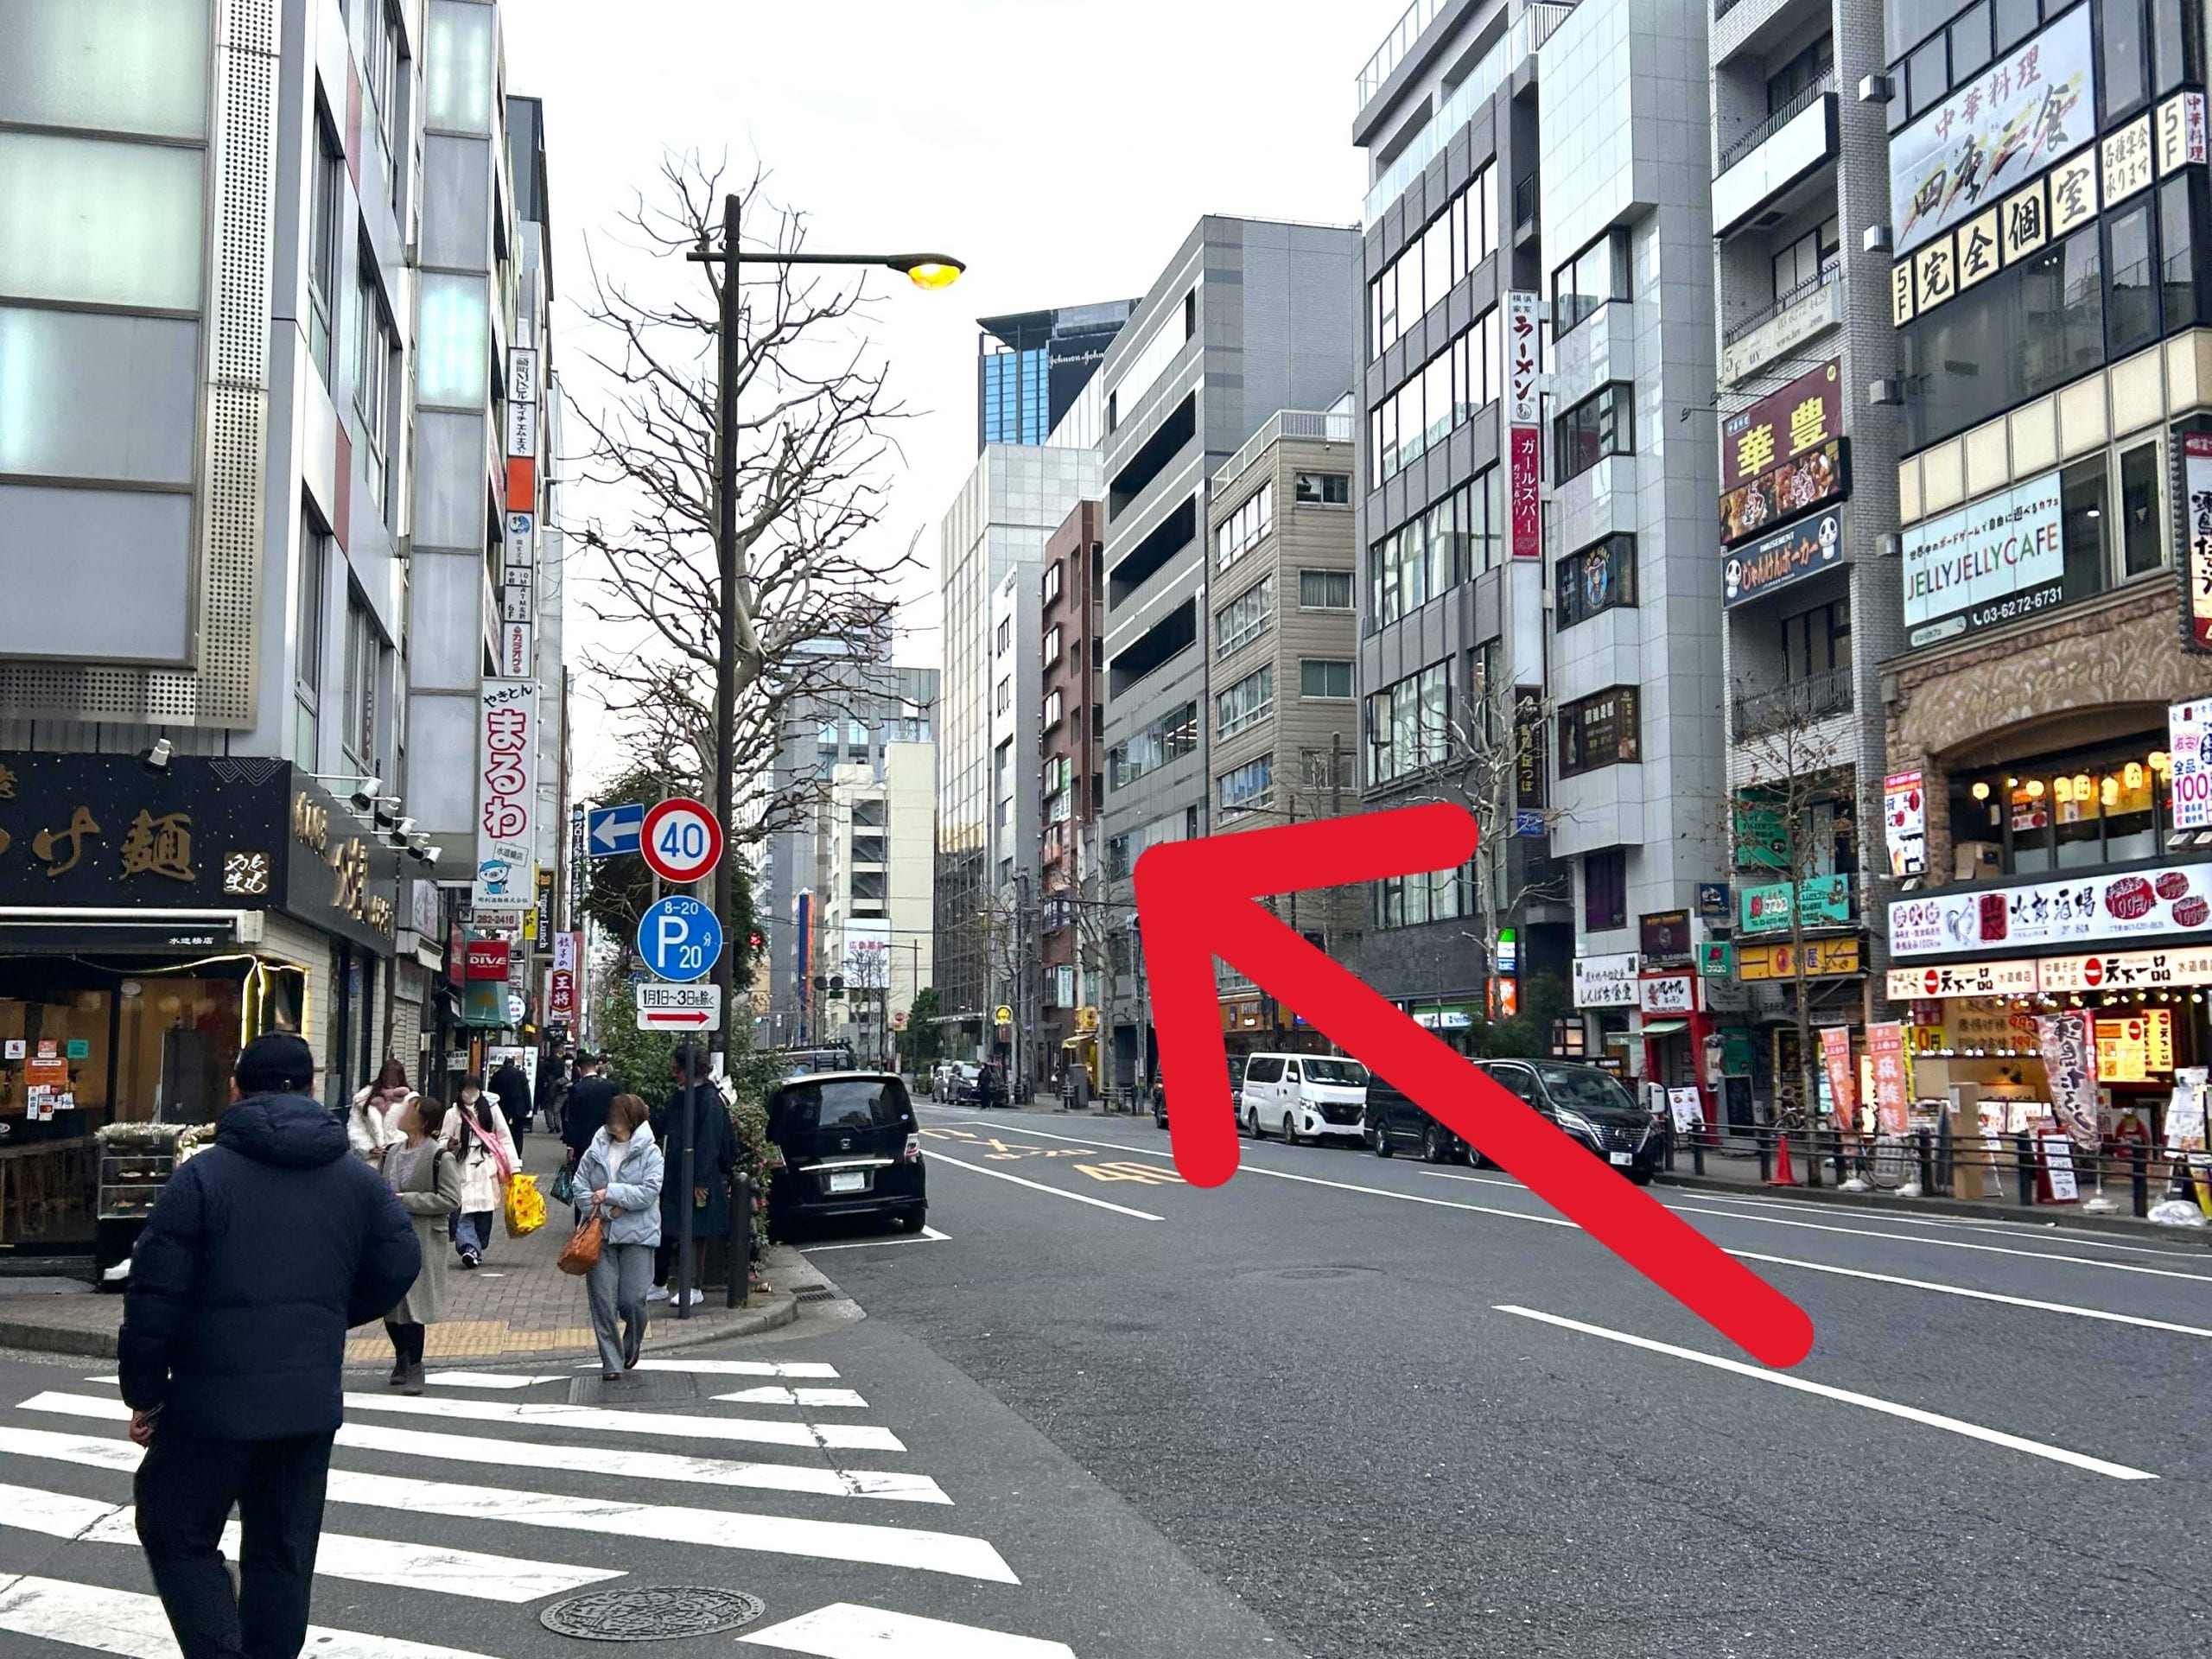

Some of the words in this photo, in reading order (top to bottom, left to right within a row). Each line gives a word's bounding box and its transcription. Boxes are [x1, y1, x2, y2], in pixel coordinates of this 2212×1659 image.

[1936, 44, 2042, 142] 中華料理
[2165, 102, 2178, 168] 5F
[2188, 95, 2204, 162] 中華料理
[1923, 168, 2091, 303] 完全個室
[1897, 266, 1907, 321] 5F
[1513, 315, 1535, 400] ラーメン
[1521, 439, 1535, 533] ガールズバー
[1982, 586, 2063, 624] 03-6272-6731
[483, 683, 533, 708] やきとん
[485, 709, 526, 838] まるわ
[2174, 758, 2196, 775] 全品
[2175, 772, 2209, 803] 100
[0, 806, 195, 882] け麺
[660, 823, 703, 859] 40
[664, 901, 699, 915] 8-20
[539, 919, 549, 949] Lunch
[658, 916, 690, 968] P
[703, 931, 712, 947] 分
[469, 957, 507, 965] DIVE
[679, 945, 702, 969] 20
[2045, 962, 2077, 972] 中華そば
[2105, 955, 2171, 984] 天下一品
[2177, 959, 2212, 973] 水道橋
[556, 976, 571, 1007] 王将
[1941, 967, 1993, 993] 天下一品
[1999, 971, 2031, 982] 水道橋店
